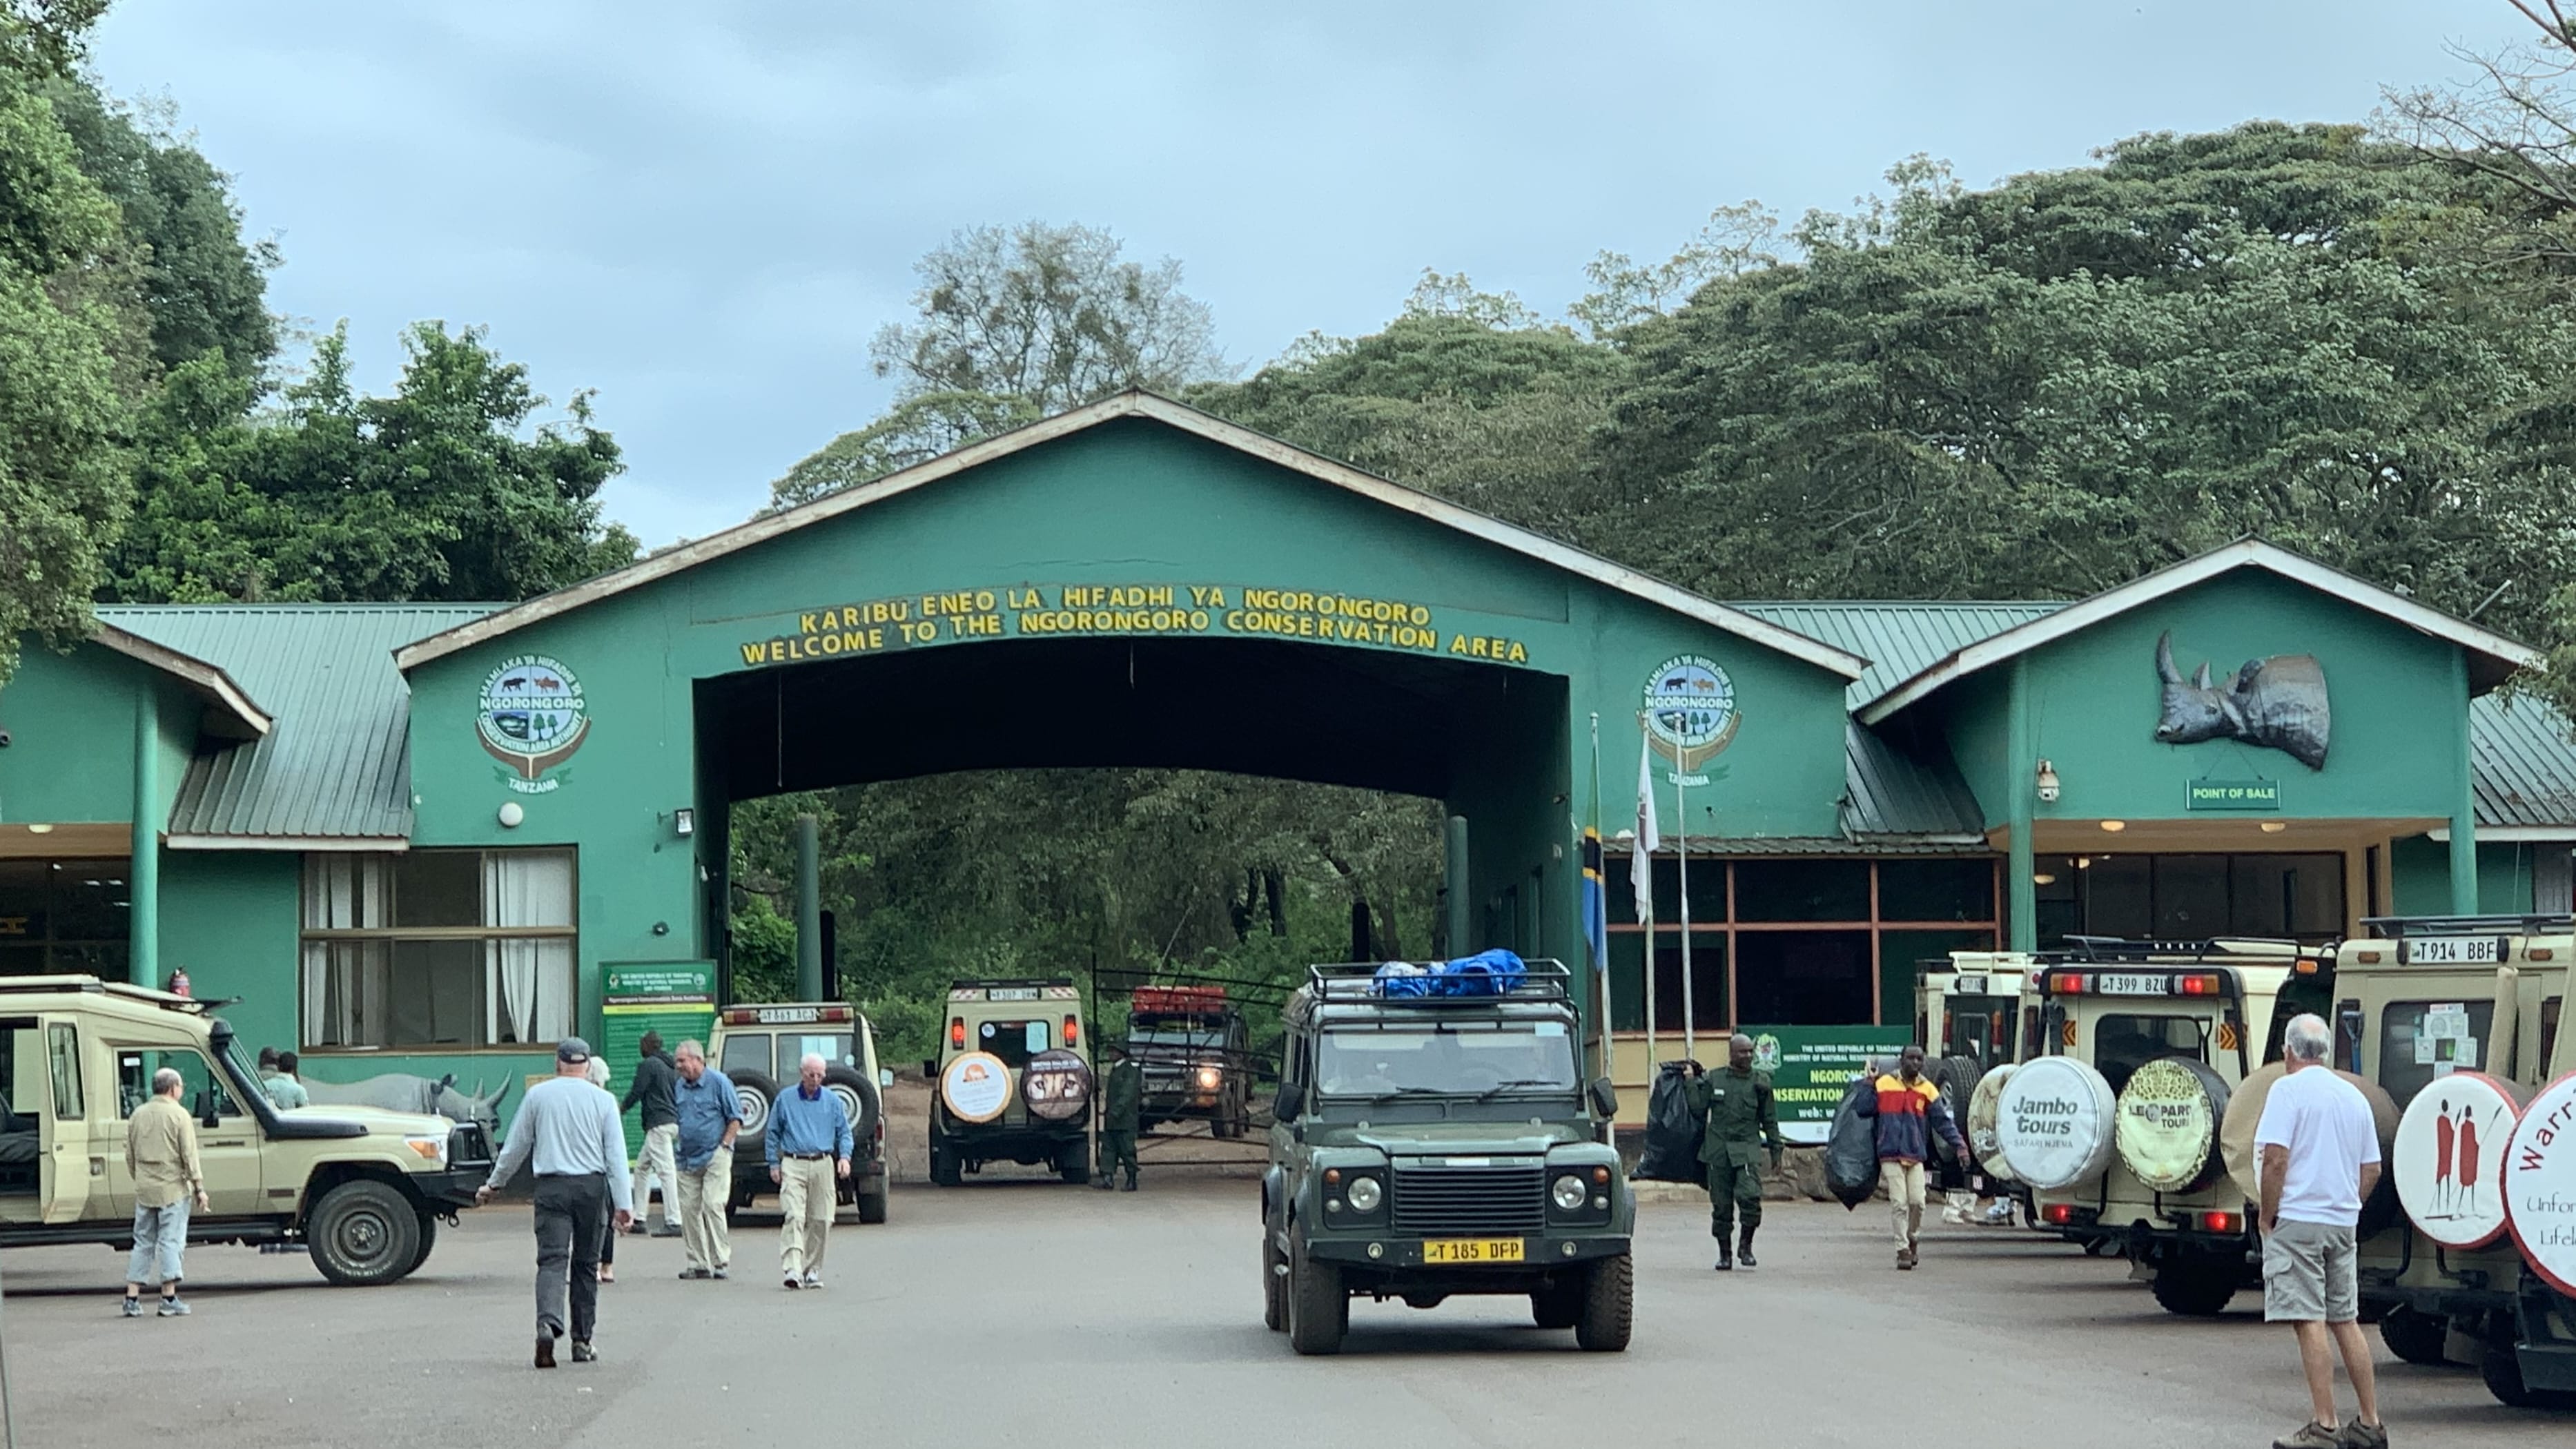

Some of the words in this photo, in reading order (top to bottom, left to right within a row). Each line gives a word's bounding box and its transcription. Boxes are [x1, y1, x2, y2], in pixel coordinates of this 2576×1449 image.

[801, 600, 909, 634] KARIBU
[922, 591, 995, 614] ENEO
[1008, 589, 1040, 610] LA
[1064, 586, 1173, 606] HIFADHI
[1189, 586, 1225, 607] YA
[1245, 588, 1430, 625] NGORONGORO
[742, 631, 884, 663] WELCOME
[901, 621, 937, 643] TO
[951, 614, 1002, 634] THE
[1021, 610, 1210, 632] NGORONGORO
[1227, 610, 1436, 649] CONSERVATION
[1452, 634, 1527, 661] AREA
[480, 657, 524, 697] MAMLAKA
[524, 655, 536, 665] YA
[537, 656, 576, 684] HIFADHI
[571, 681, 583, 697] YA
[1644, 657, 1680, 696] MAMLAKA
[1694, 656, 1730, 685] HIFADHI
[480, 697, 585, 710] NGORONGORO
[1646, 696, 1734, 710] NGORONGORO
[507, 777, 559, 794] TANZANIA
[2193, 788, 2227, 799] POINT
[2228, 788, 2243, 799] OF
[2246, 788, 2275, 799] SALE
[2419, 942, 2427, 960] T
[2430, 942, 2456, 960] 914
[2468, 942, 2495, 960] BBF
[2109, 977, 2115, 991] T
[2117, 978, 2137, 992] 399
[2145, 978, 2167, 992] BZU
[1802, 1044, 1813, 1053] THE
[1797, 1106, 1823, 1118] web:
[2012, 1096, 2078, 1115] Jambo
[2016, 1116, 2071, 1134] tours
[2519, 1088, 2576, 1171] Warr
[2540, 1224, 2576, 1245] Lifel
[1437, 1244, 1445, 1260] T
[1451, 1243, 1479, 1260] 185
[1490, 1242, 1519, 1258] DFP
